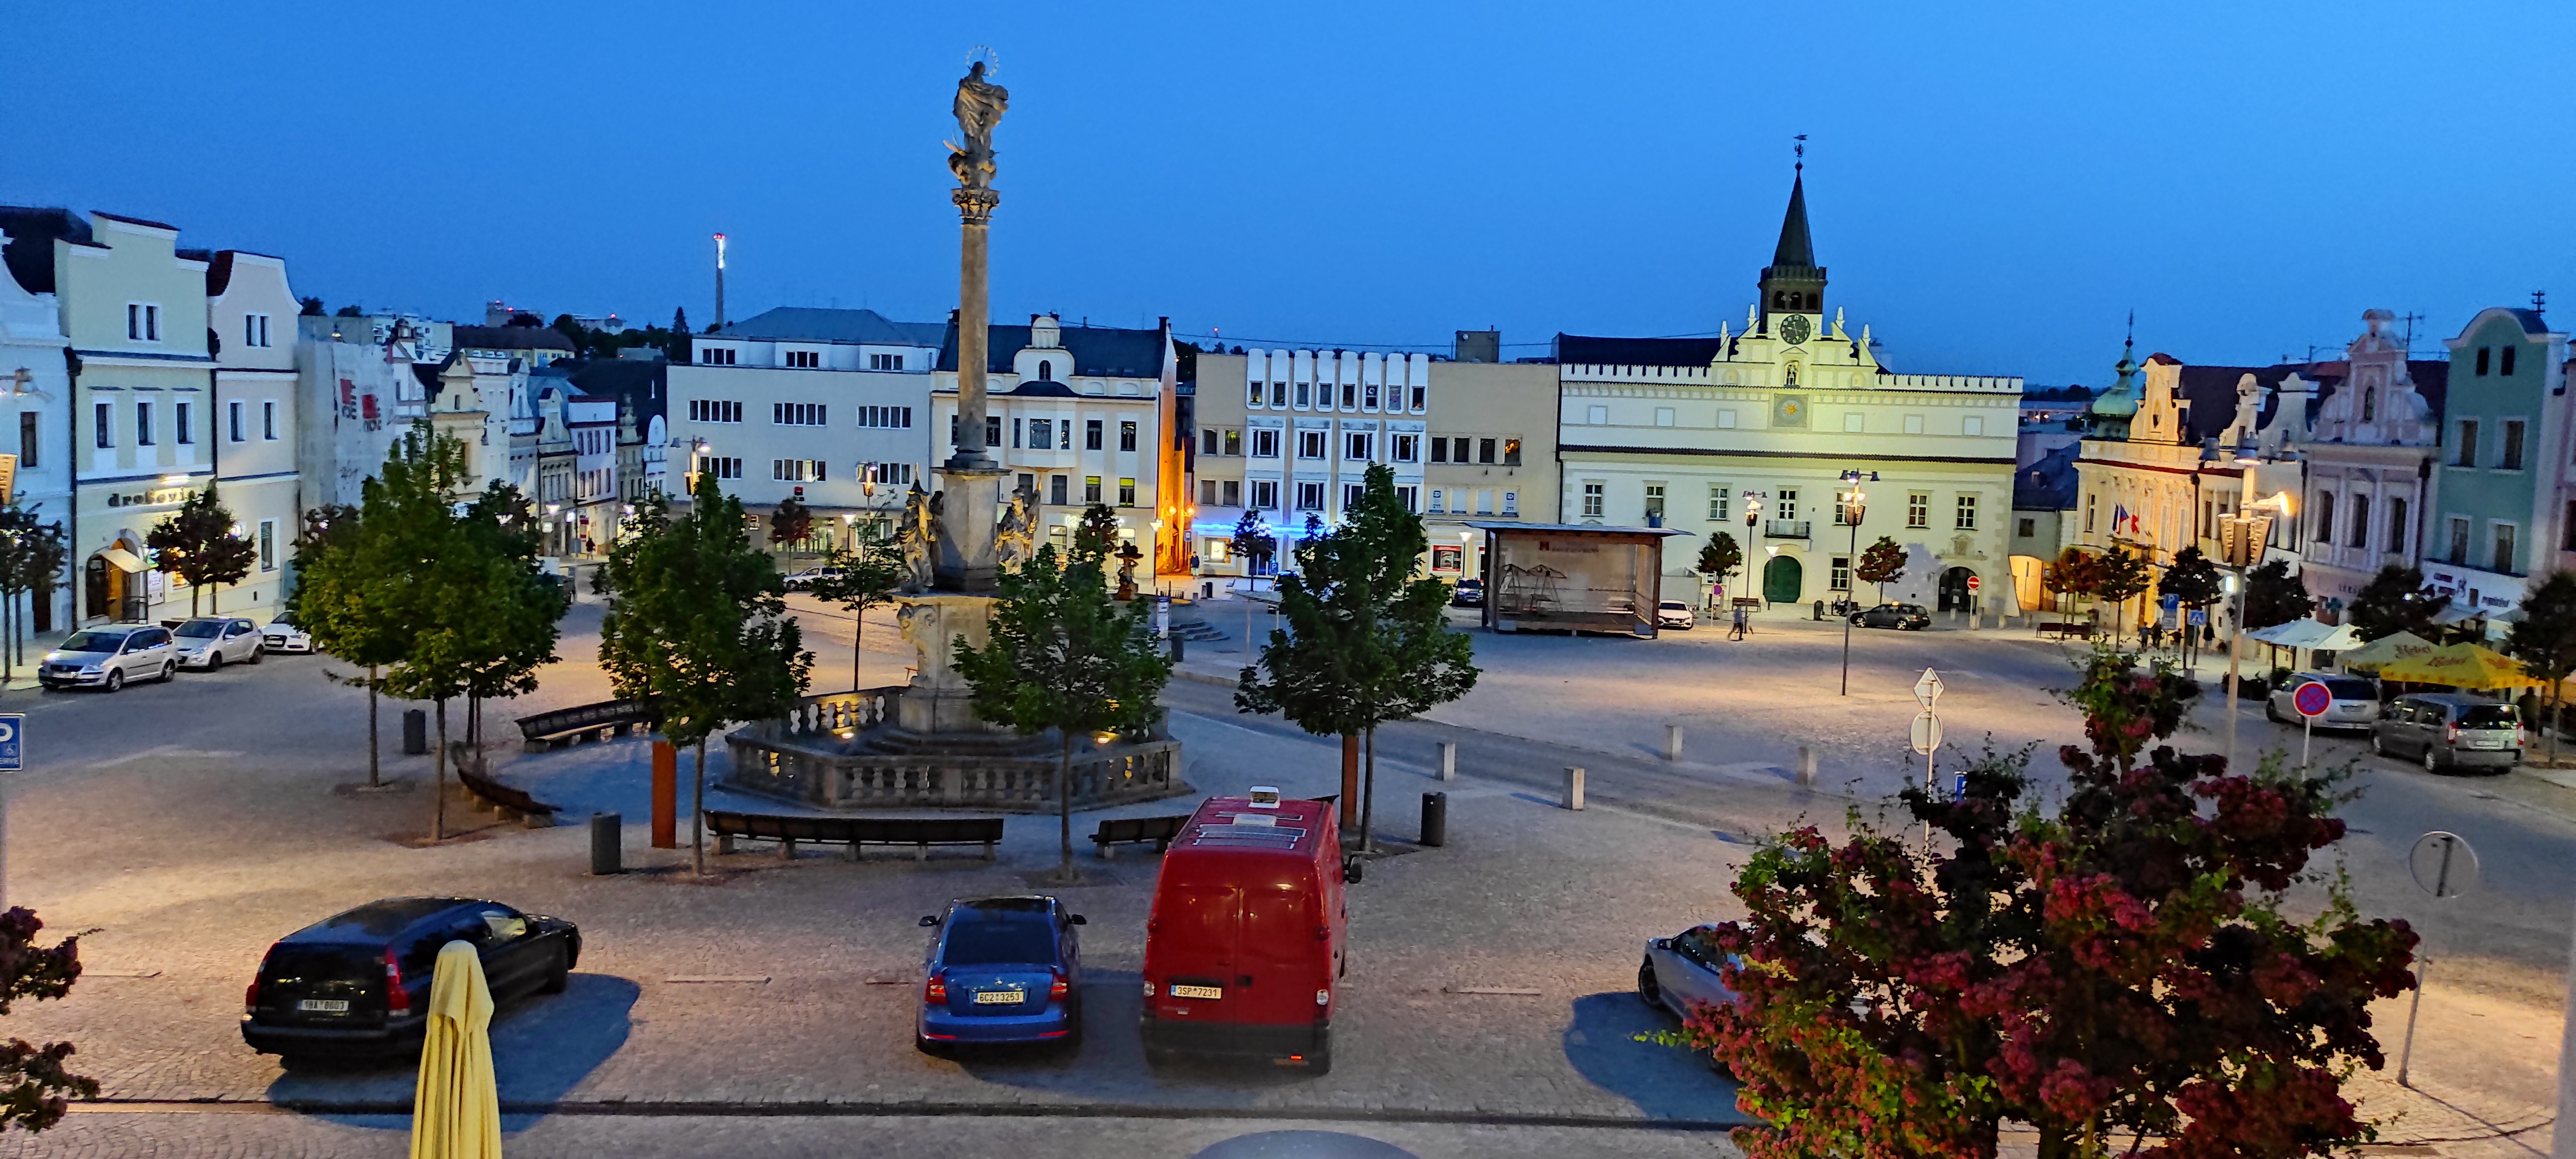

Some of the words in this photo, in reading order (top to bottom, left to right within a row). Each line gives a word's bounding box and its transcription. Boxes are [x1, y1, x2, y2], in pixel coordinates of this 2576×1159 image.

[1178, 986, 1192, 995] 3SP
[1198, 988, 1217, 997] 7231
[979, 994, 994, 1002] 6C2
[1000, 993, 1019, 1001] 3253
